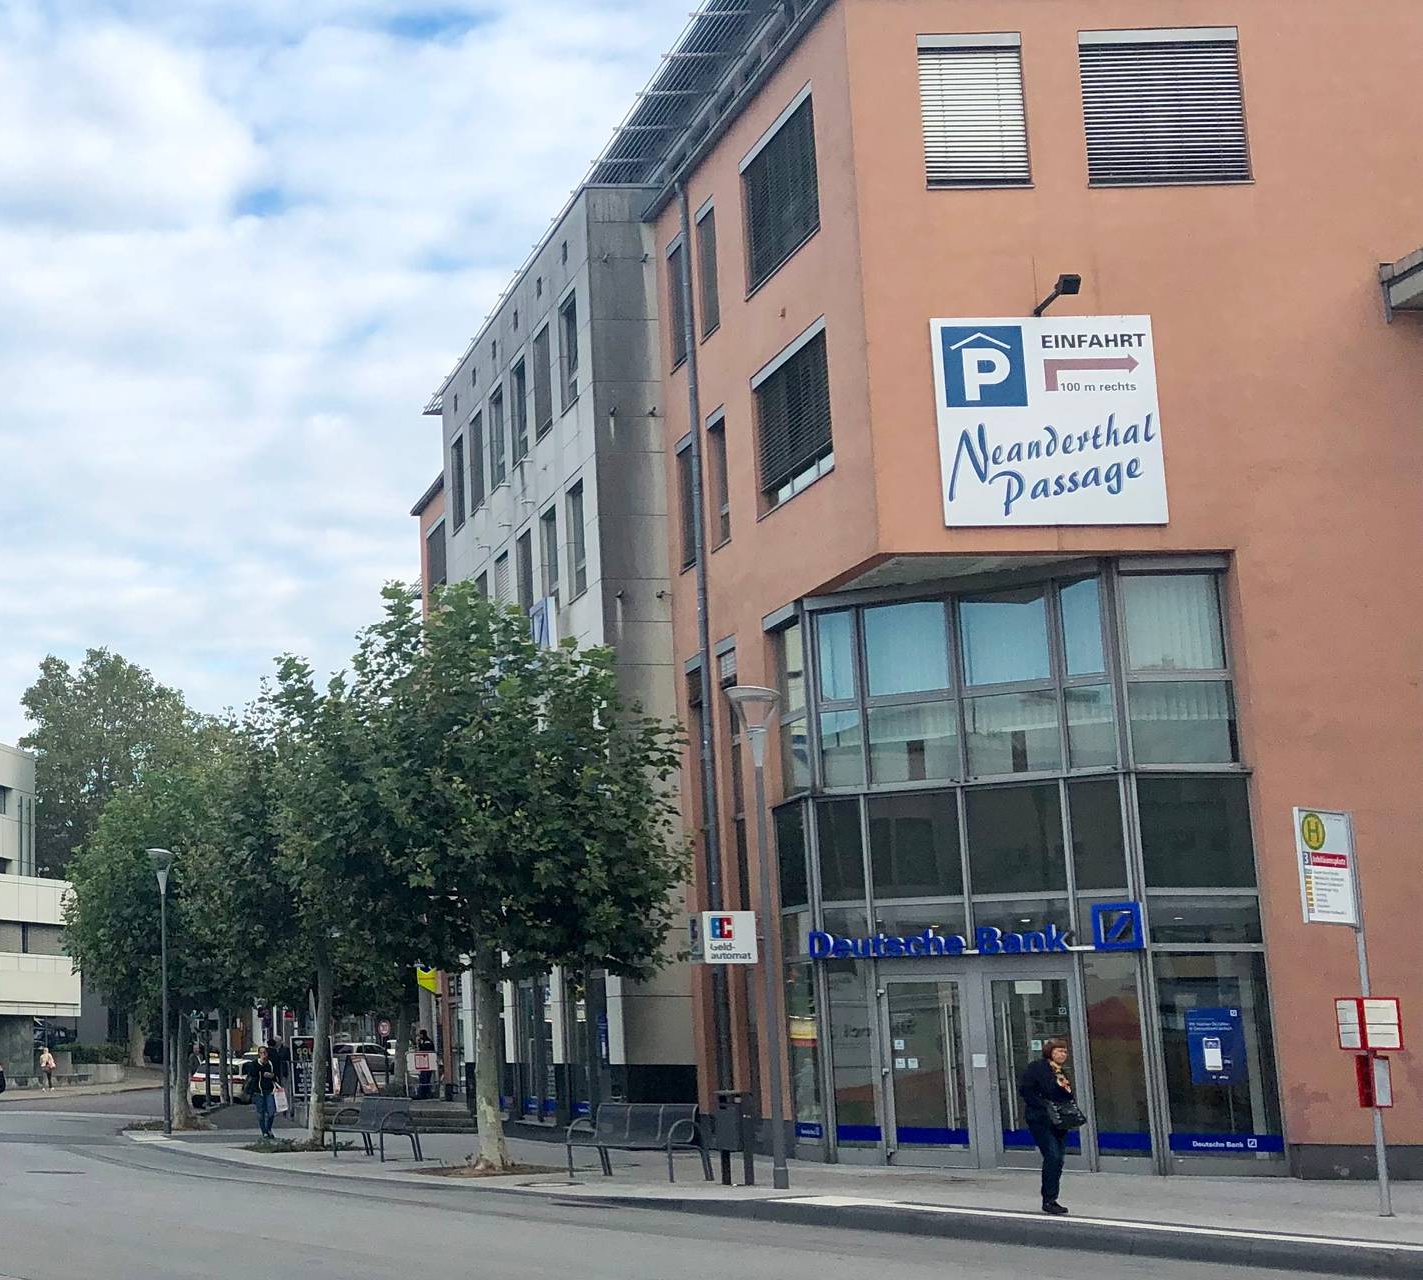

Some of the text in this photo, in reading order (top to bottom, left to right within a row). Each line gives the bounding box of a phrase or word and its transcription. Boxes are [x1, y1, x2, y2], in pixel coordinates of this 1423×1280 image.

[1041, 333, 1146, 349] EINFAHRT
[961, 348, 1011, 401] P
[1060, 382, 1137, 392] 100 m rechts
[948, 412, 1156, 502] Neanderthal
[988, 457, 1144, 517] Passage
[710, 943, 736, 951] Geld-
[808, 923, 1075, 958] Deutsche Bank
[711, 952, 752, 960] automat
[1192, 1140, 1225, 1148] Deutsche
